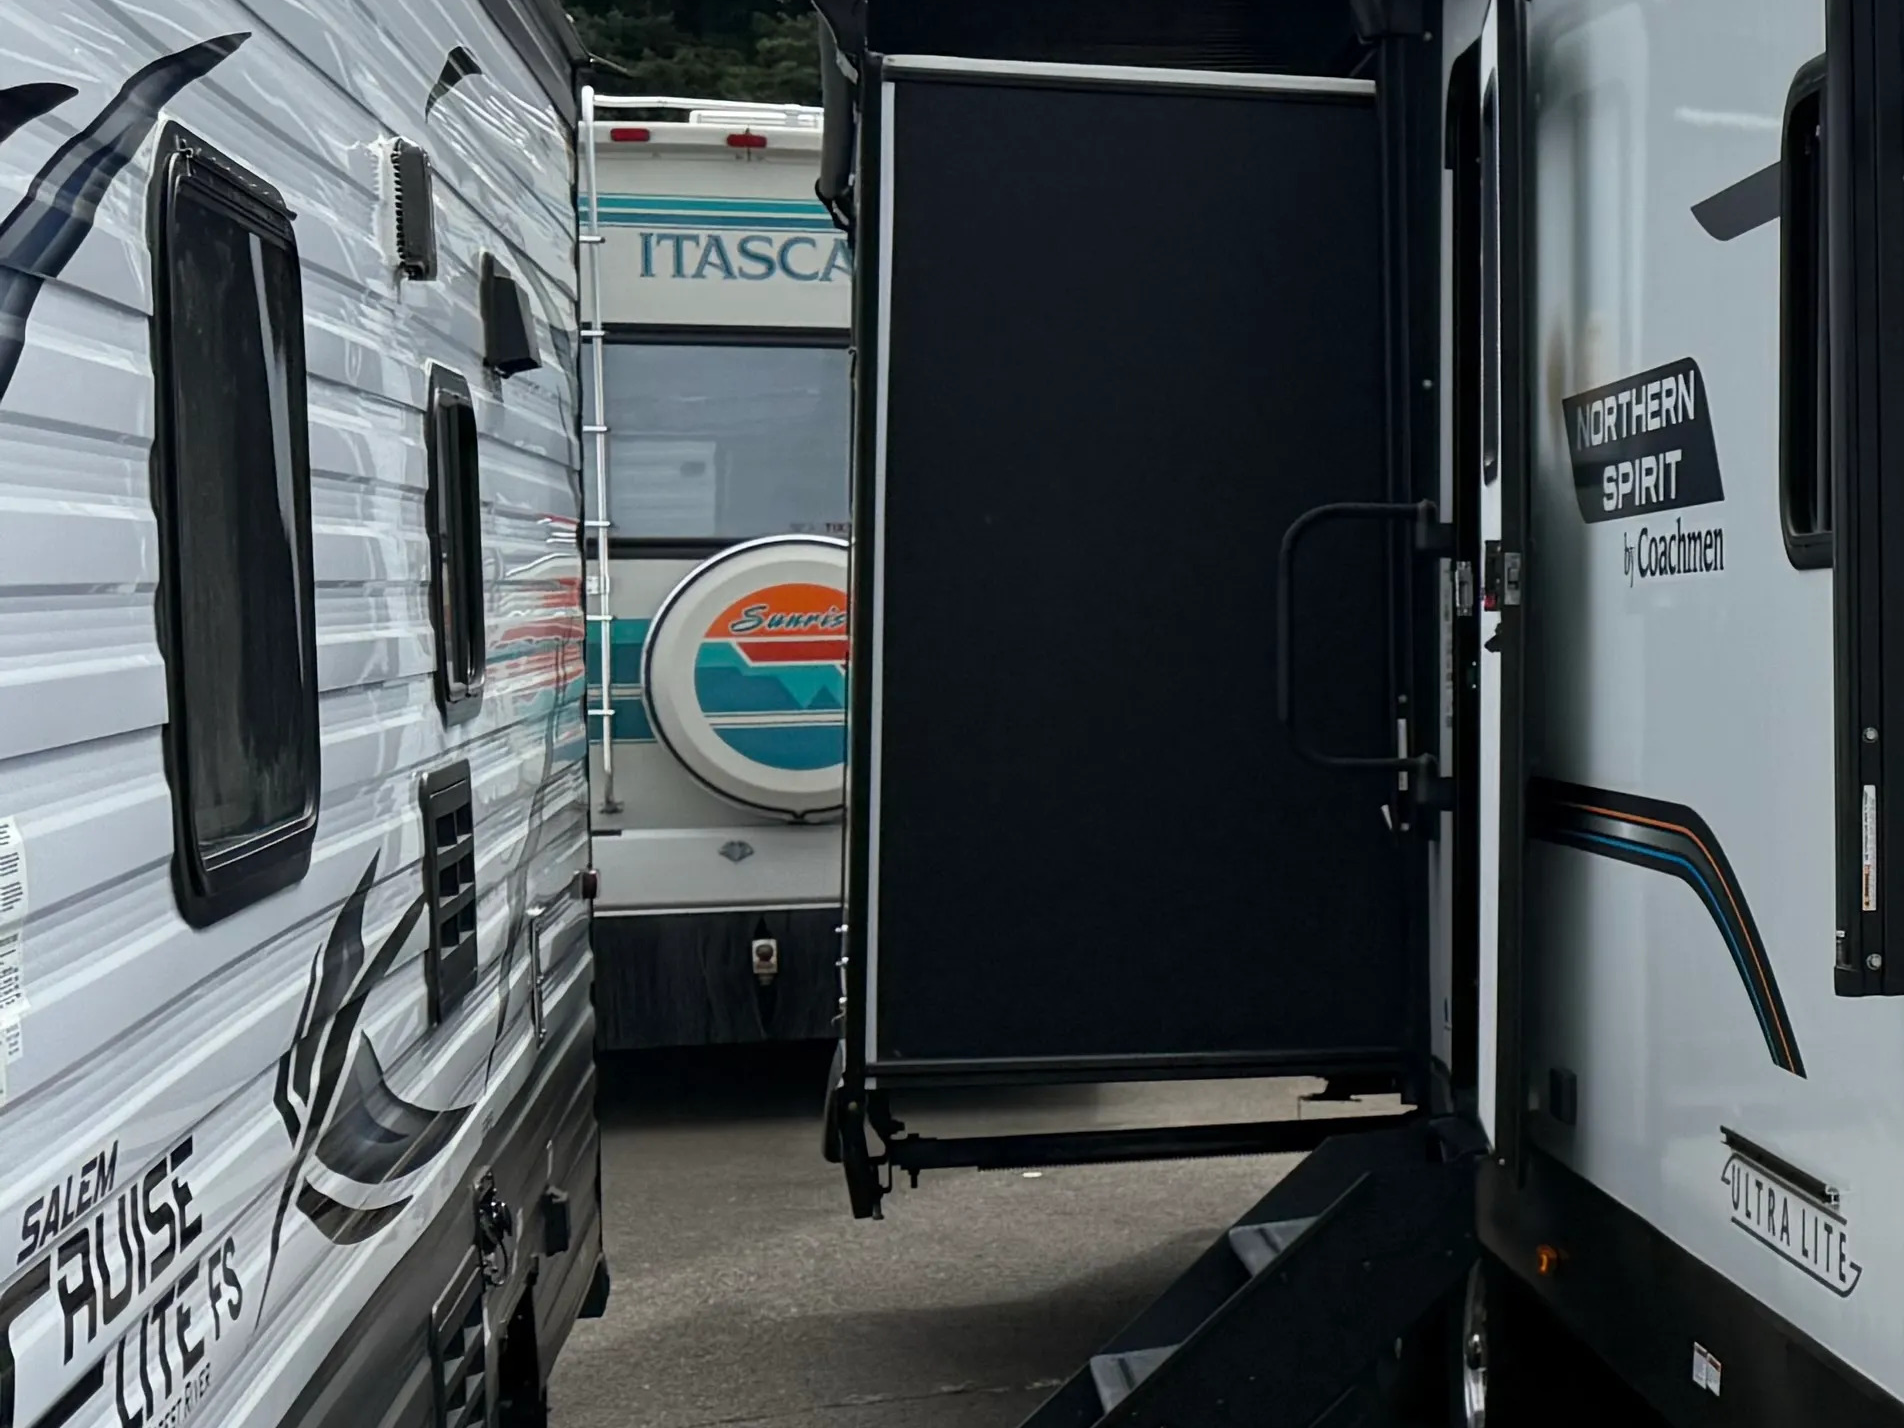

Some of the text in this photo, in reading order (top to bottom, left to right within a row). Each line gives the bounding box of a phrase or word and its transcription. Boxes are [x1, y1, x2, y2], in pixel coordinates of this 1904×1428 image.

[639, 232, 852, 282] ITASCA
[1576, 369, 1695, 451] NORTHERN
[1602, 448, 1683, 512] SPIRIT
[1623, 516, 1724, 588] by Coachmen
[729, 603, 848, 634] Sunris
[16, 1139, 119, 1265] SALEM
[1731, 1163, 1846, 1283] ULTRA LITE
[207, 1236, 243, 1341] FS
